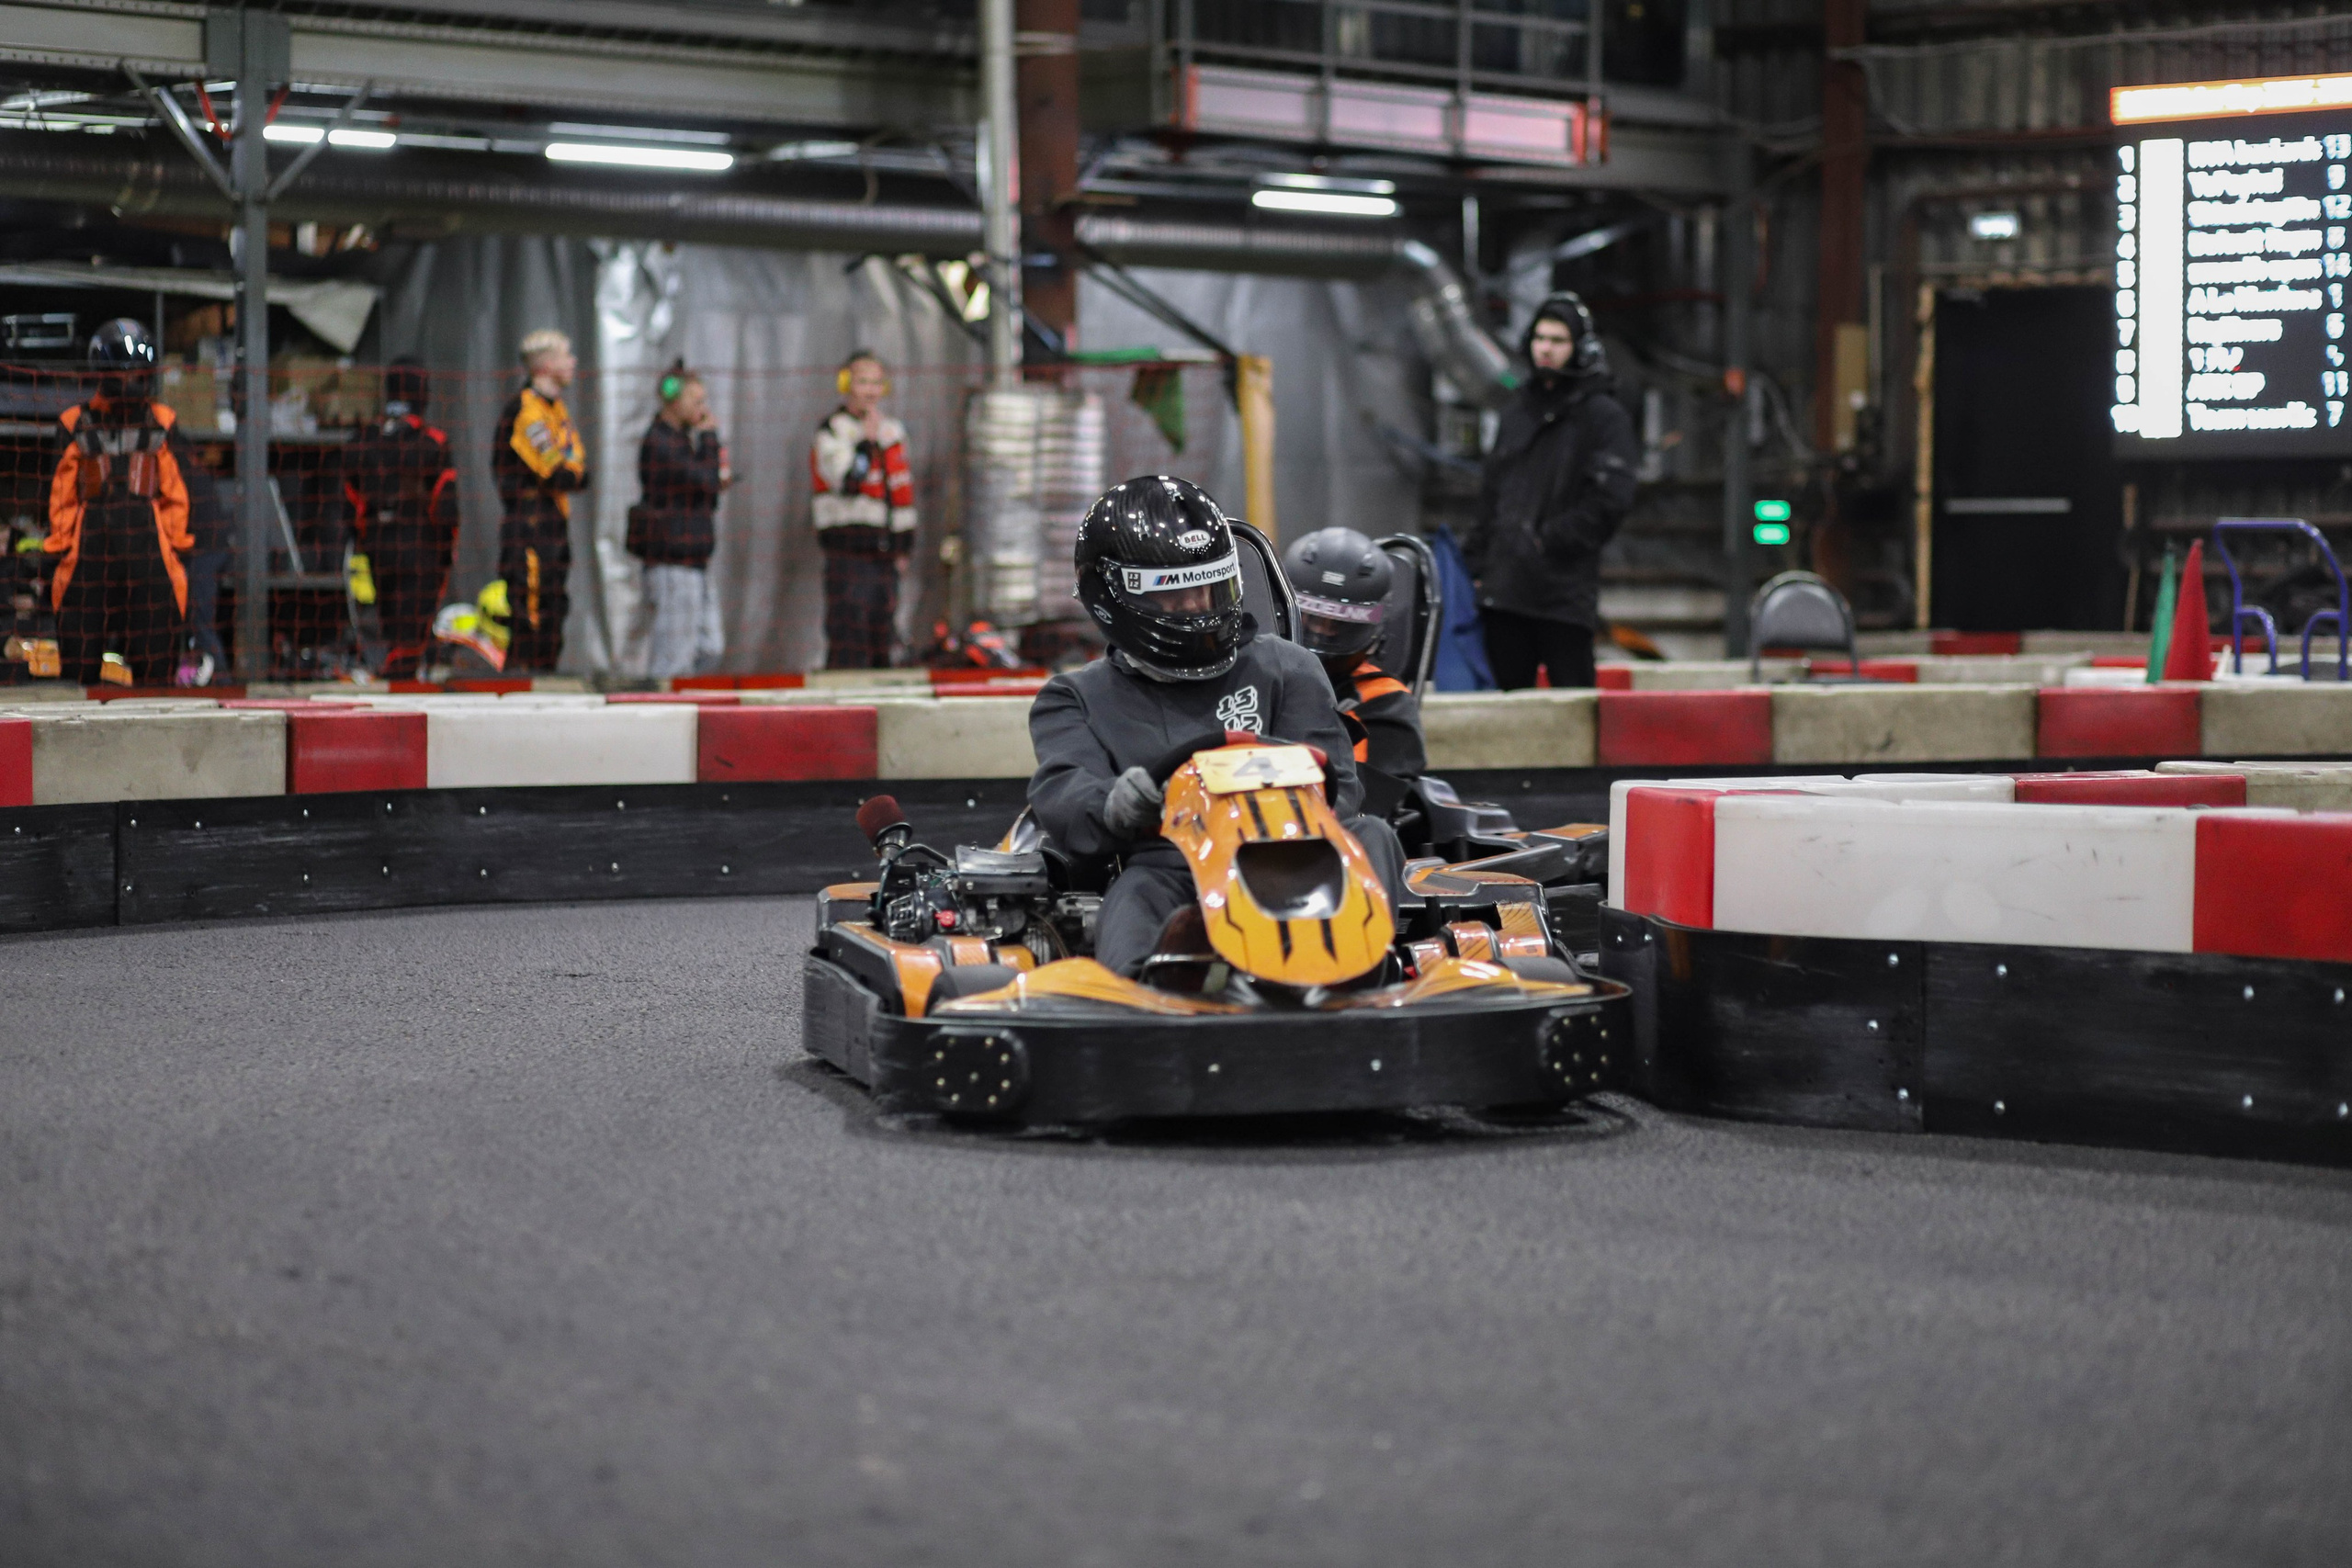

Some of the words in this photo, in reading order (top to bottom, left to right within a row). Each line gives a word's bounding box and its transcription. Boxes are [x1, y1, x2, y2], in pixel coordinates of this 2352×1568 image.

[1183, 534, 1207, 544] BELL
[1182, 562, 1236, 583] Motorsport
[1216, 685, 1258, 721] 13
[1233, 756, 1283, 784] 4
